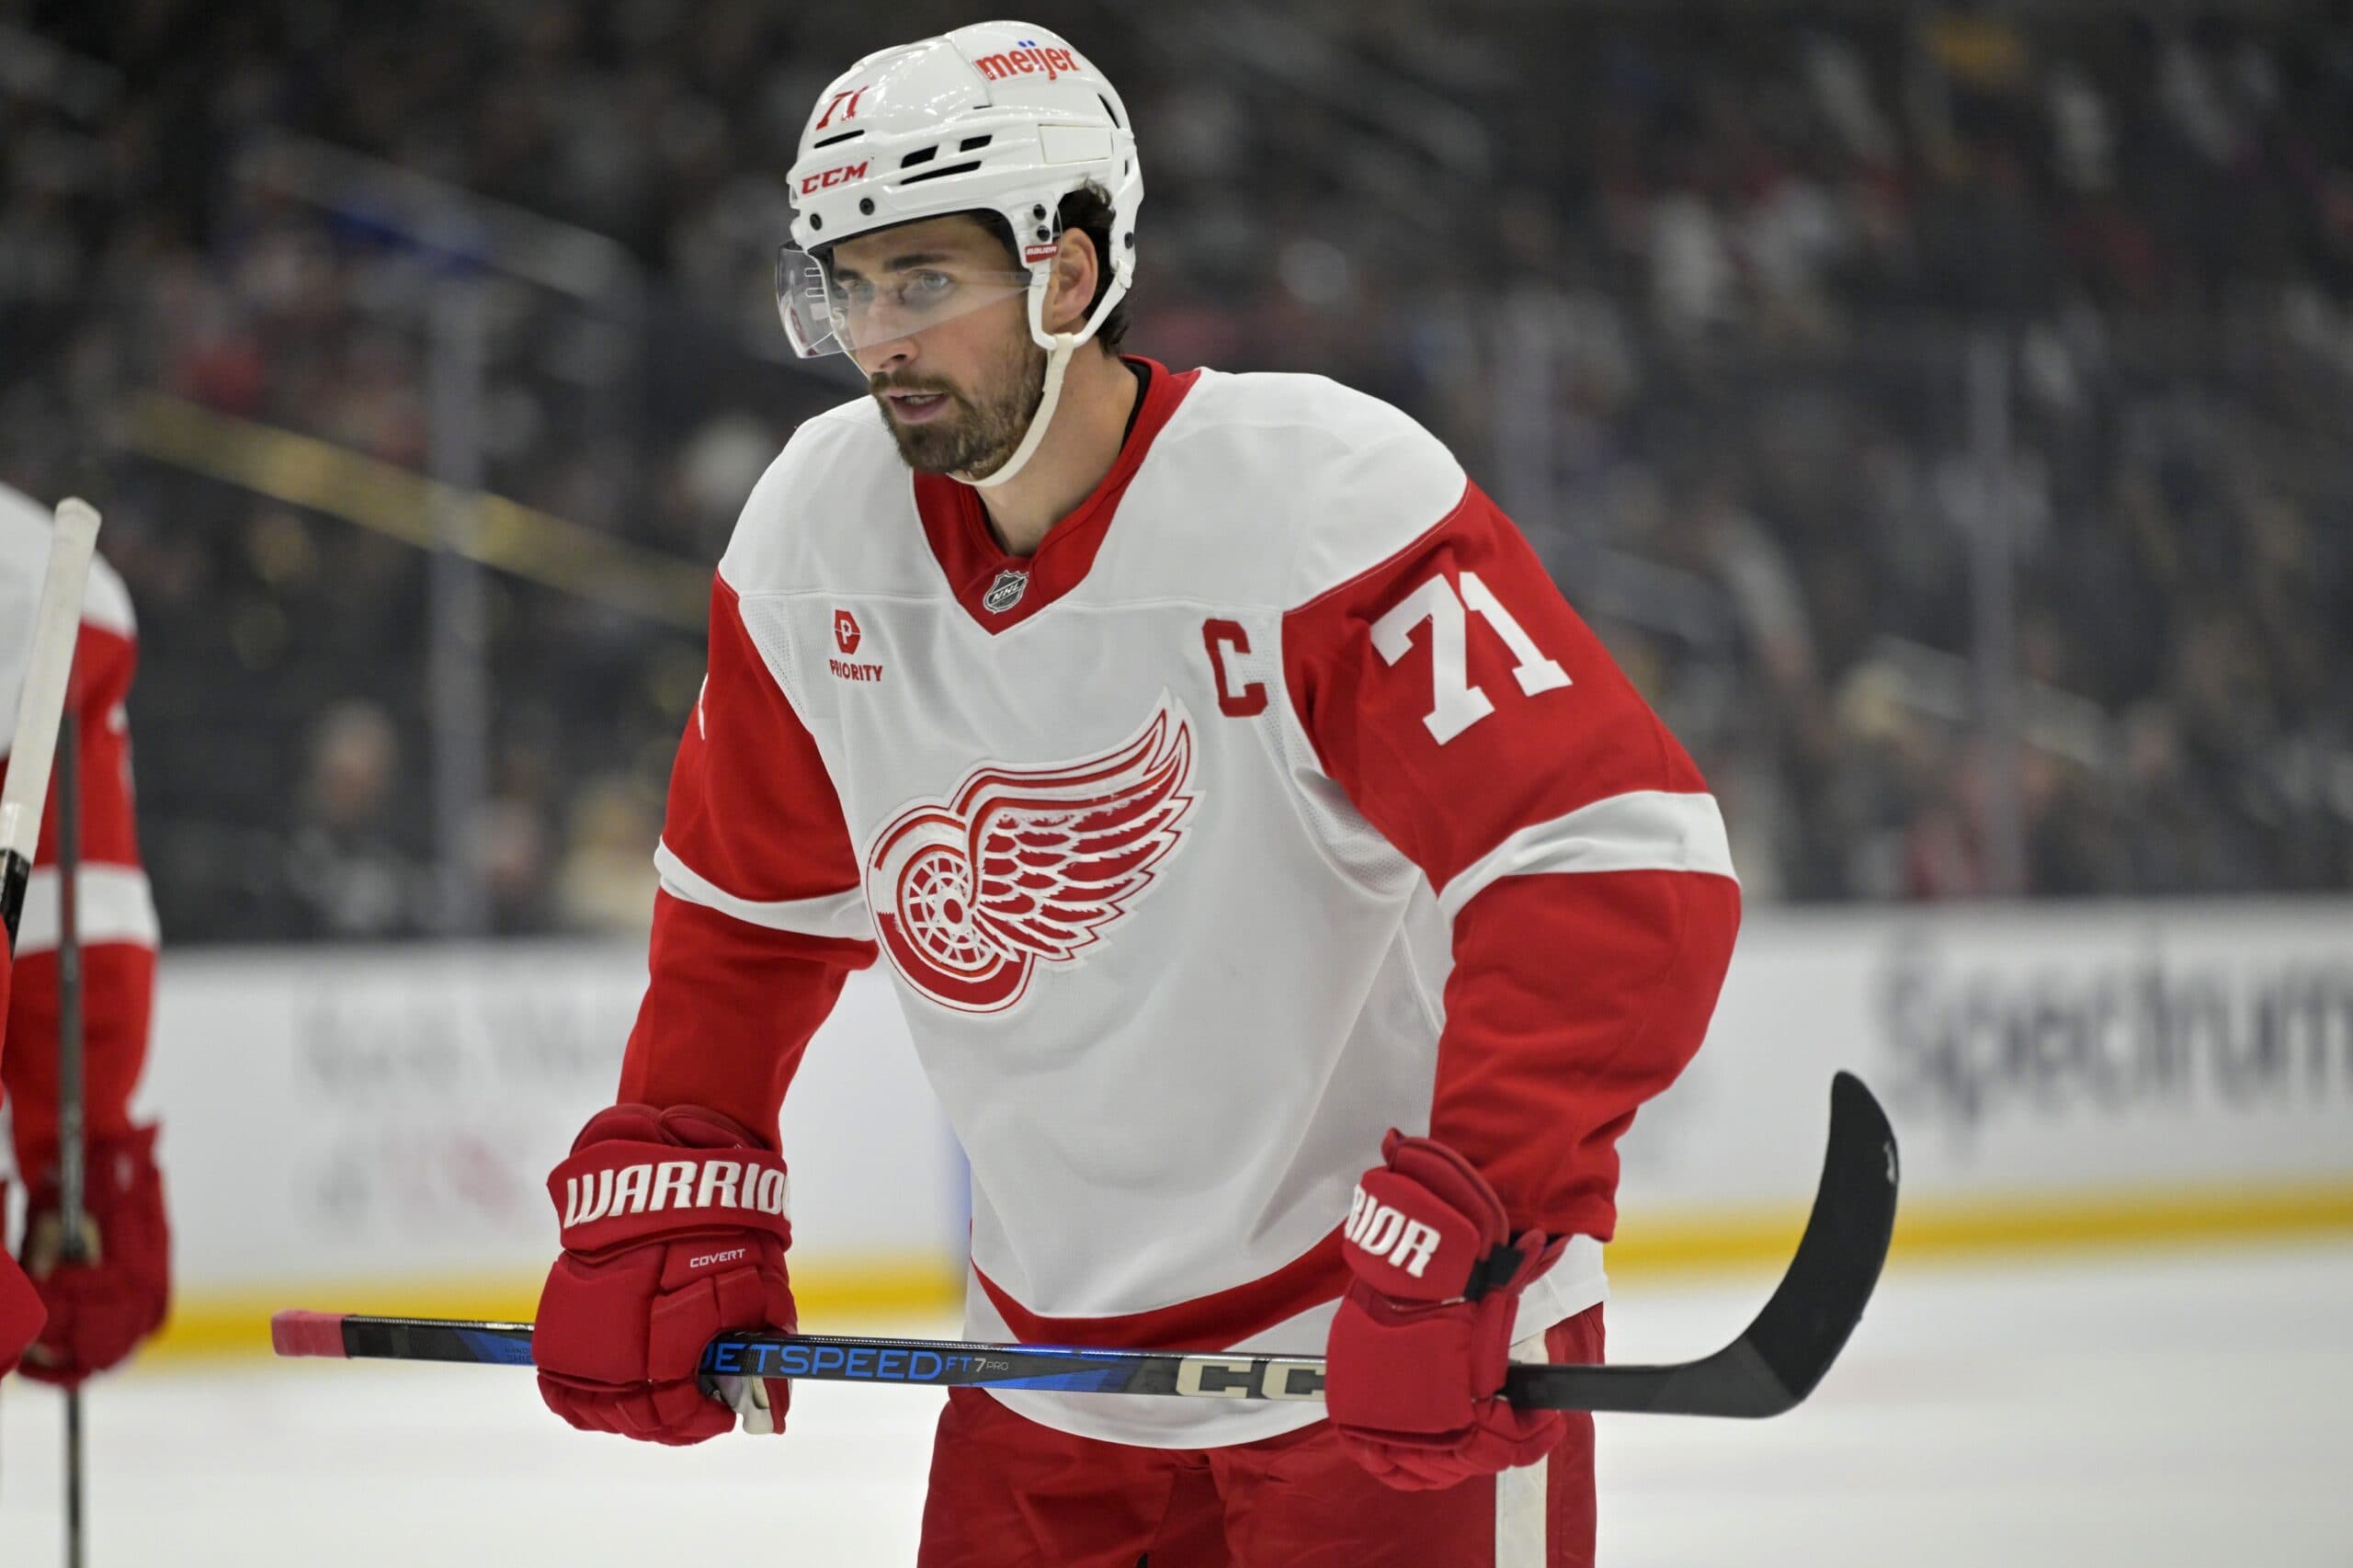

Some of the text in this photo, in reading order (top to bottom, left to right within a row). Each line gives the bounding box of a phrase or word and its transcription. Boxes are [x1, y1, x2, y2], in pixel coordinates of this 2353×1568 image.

[975, 40, 1081, 81] meijer
[816, 86, 870, 131] 71
[801, 161, 869, 195] CCM
[992, 582, 1020, 603] NHL
[829, 658, 883, 682] PRIORITY
[1202, 619, 1268, 718] C
[1370, 572, 1574, 746] 71
[563, 1160, 792, 1229] WARRIO
[689, 1248, 746, 1268] COVERT
